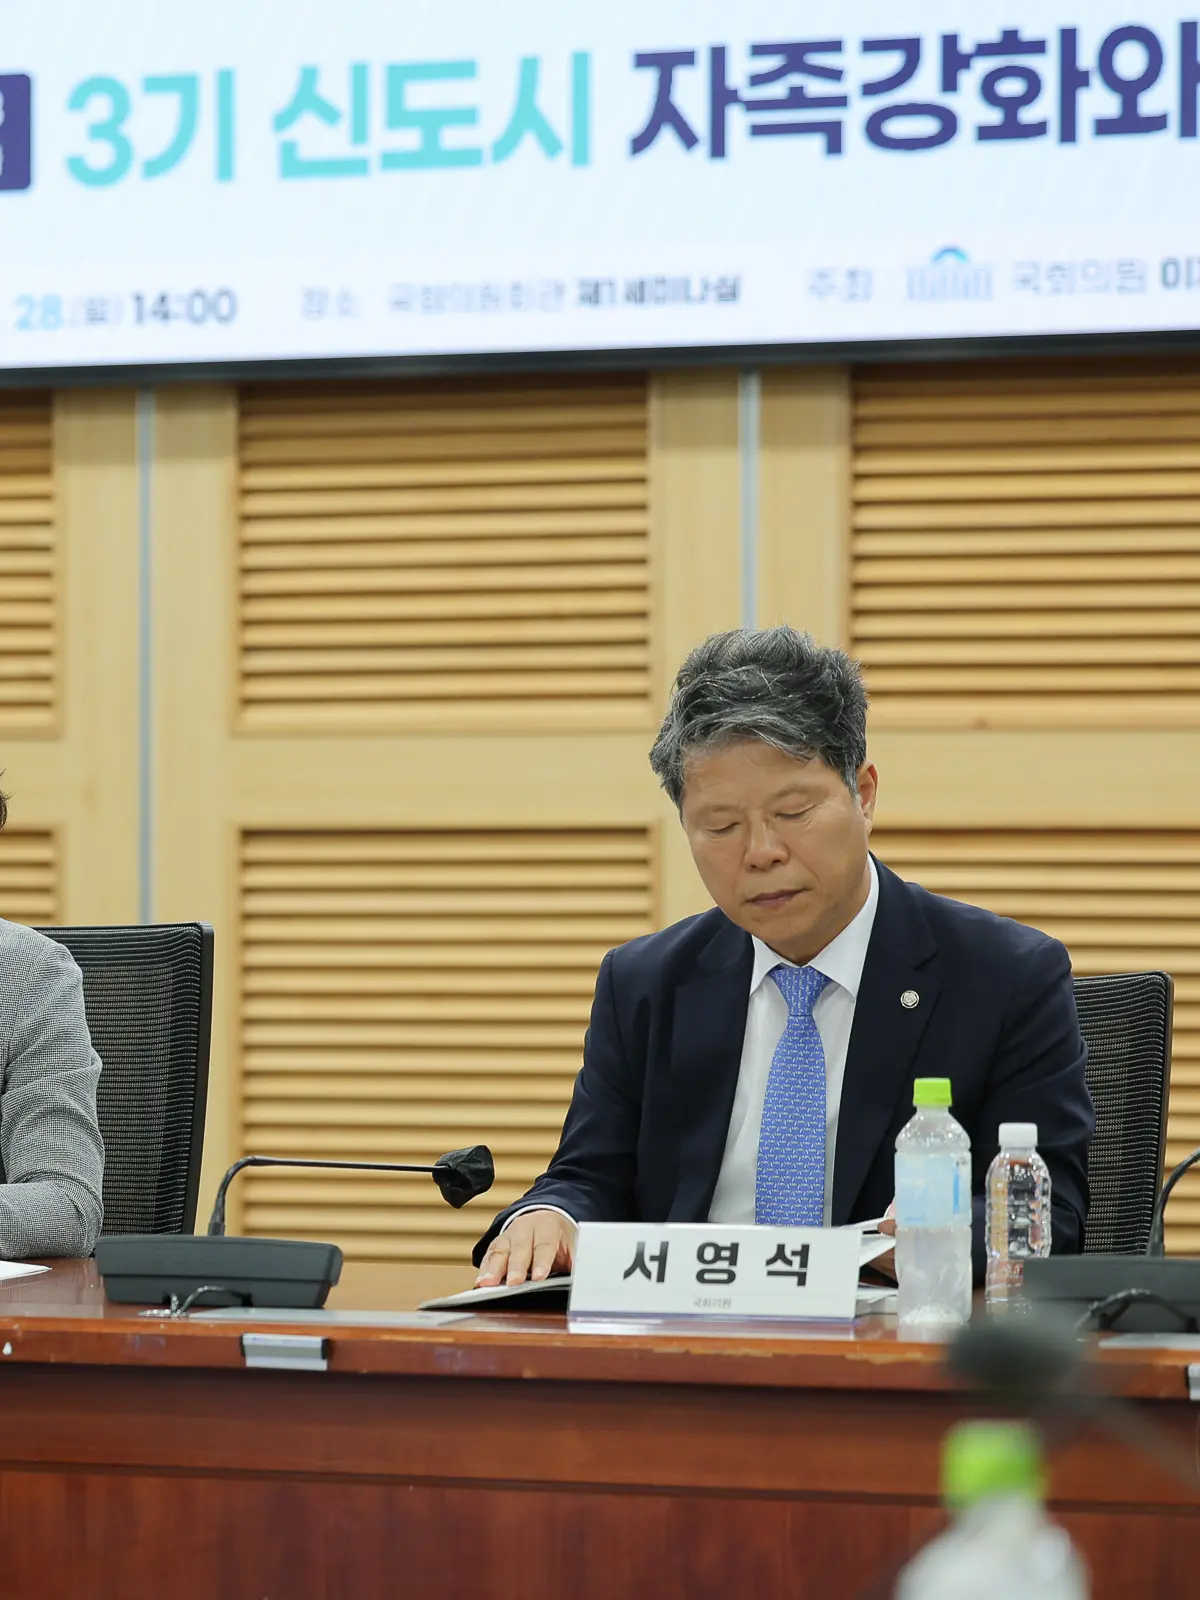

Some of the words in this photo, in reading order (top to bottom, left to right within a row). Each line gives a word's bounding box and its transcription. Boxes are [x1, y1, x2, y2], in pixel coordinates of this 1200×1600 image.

[64, 68, 234, 189] 3기
[272, 50, 591, 180] 신도시
[629, 20, 1200, 158] 자족강화와
[131, 289, 238, 327] 14:00
